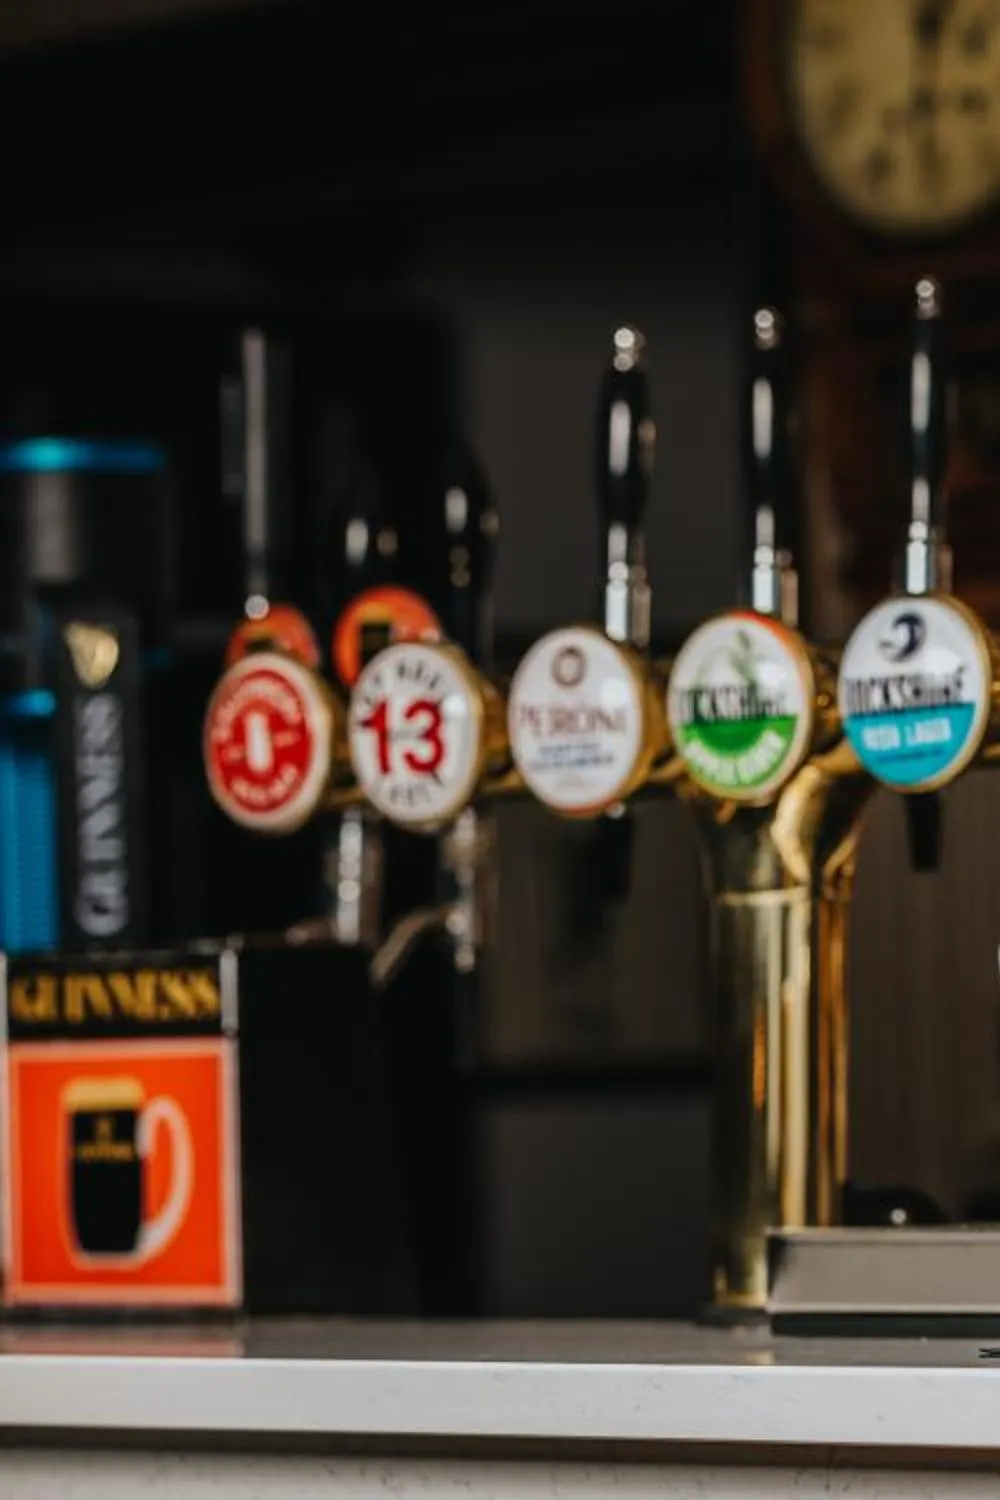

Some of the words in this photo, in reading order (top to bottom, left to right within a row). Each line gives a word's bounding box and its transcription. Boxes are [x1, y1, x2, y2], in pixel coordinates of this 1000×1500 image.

[361, 699, 446, 777] 13
[74, 692, 129, 936] GUINNESS
[10, 966, 220, 1022] GUINNESS
